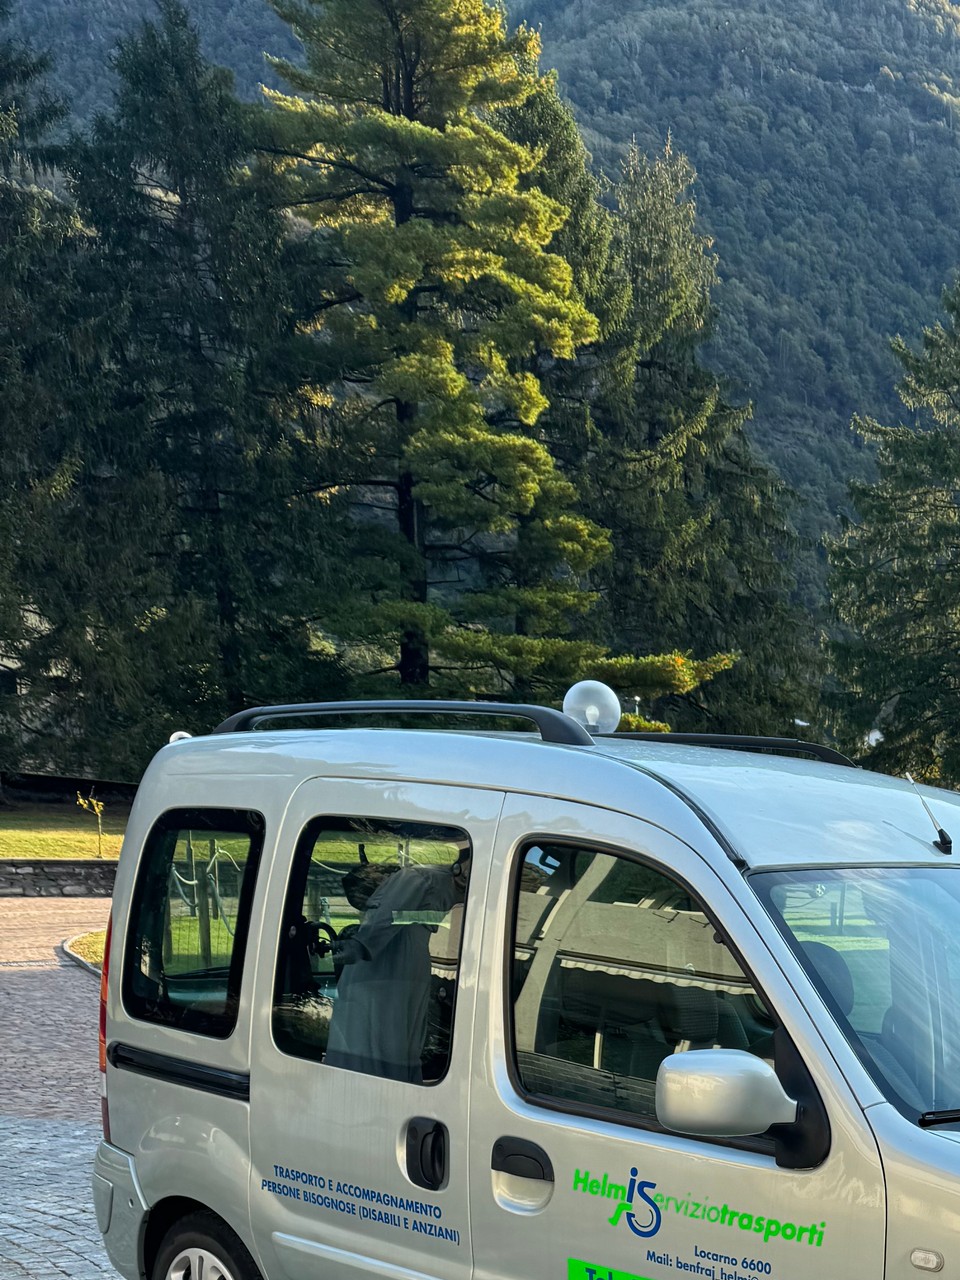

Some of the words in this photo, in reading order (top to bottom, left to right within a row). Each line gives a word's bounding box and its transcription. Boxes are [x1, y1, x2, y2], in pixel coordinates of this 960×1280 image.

[261, 1179, 301, 1200] PERSONE
[303, 1190, 357, 1215] BISOGNOSE
[359, 1205, 401, 1227] (DISABILI
[403, 1217, 410, 1229] E
[412, 1219, 460, 1246] ANZIANI)
[273, 1164, 326, 1189] TRASPORTO
[328, 1179, 334, 1191] E
[336, 1181, 442, 1219] ACCOMPAGNAMENTO
[646, 1250, 673, 1266] Mail:
[694, 1245, 738, 1266] Locarno
[741, 1257, 772, 1275] 6600
